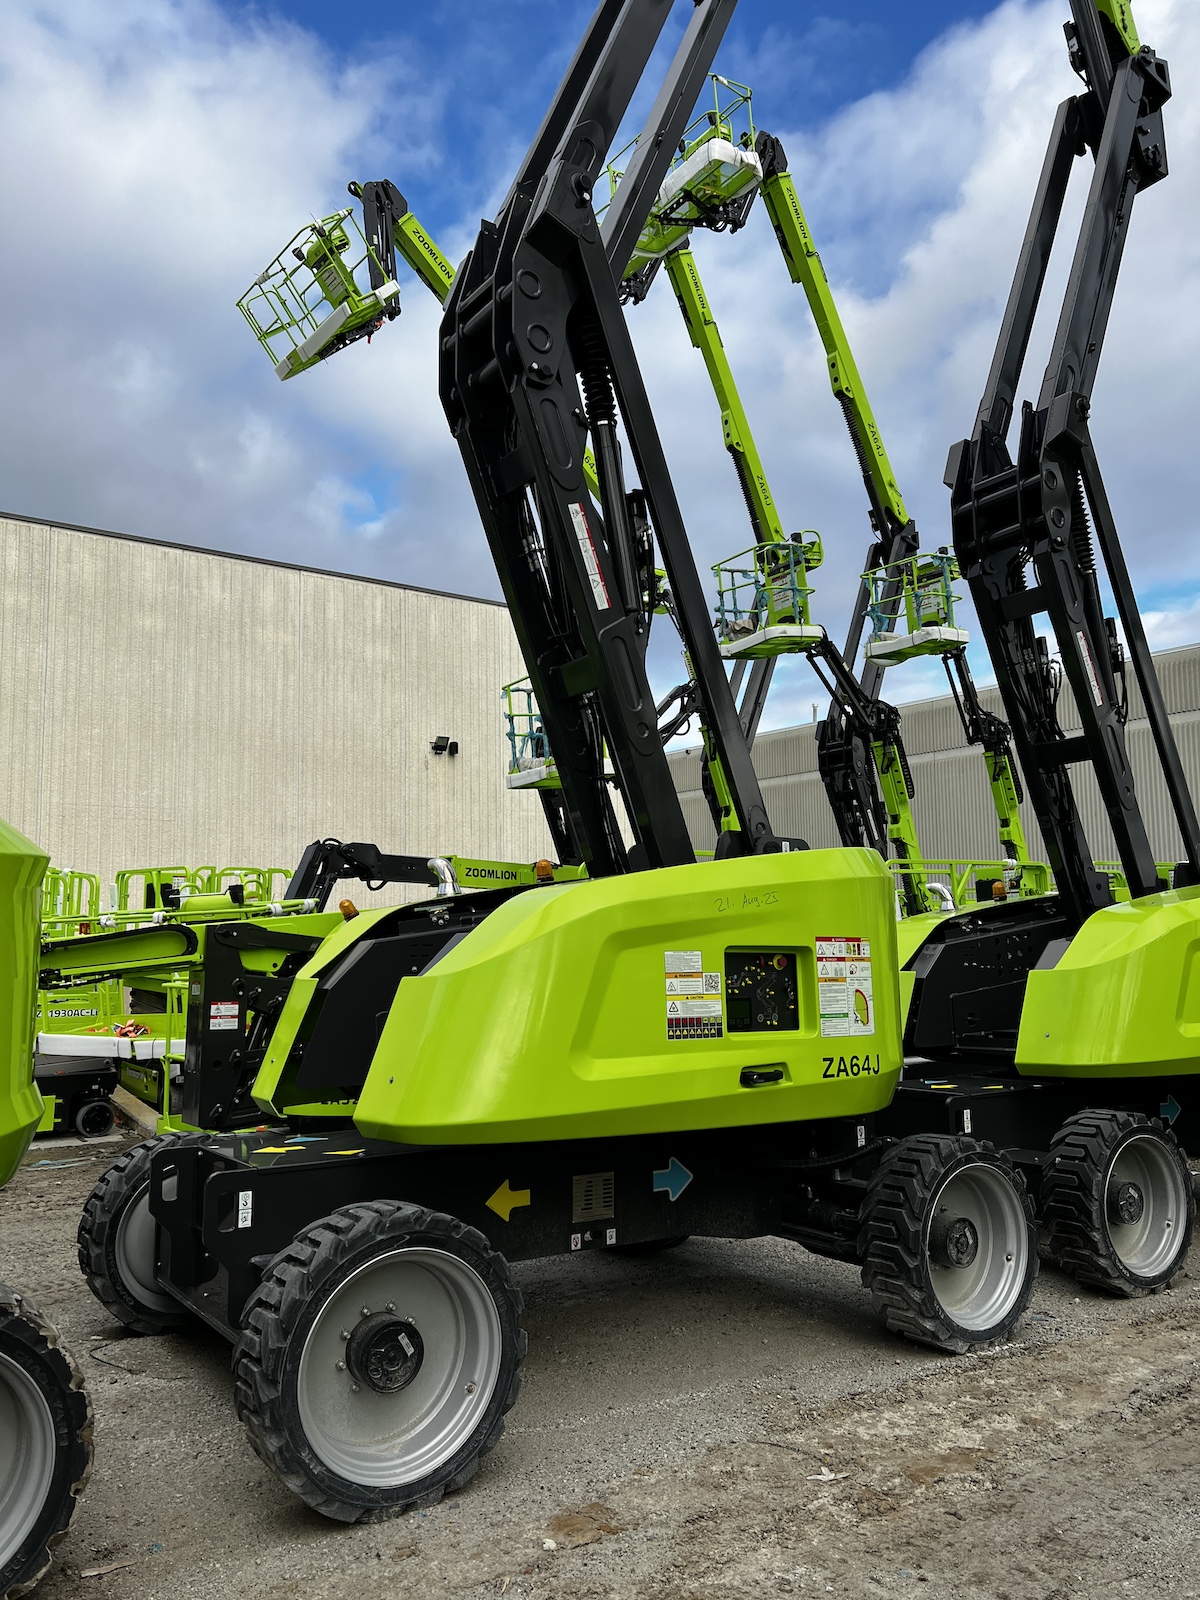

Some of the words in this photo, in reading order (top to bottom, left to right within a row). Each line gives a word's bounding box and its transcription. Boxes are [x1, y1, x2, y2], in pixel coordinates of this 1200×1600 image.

[786, 186, 808, 239] ZOOMLION
[411, 227, 453, 280] ZOOMLION
[686, 262, 706, 309] ZOOMLION
[867, 422, 884, 457] ZA64J
[465, 867, 517, 881] ZOOMLION
[822, 1053, 880, 1079] ZA64J
